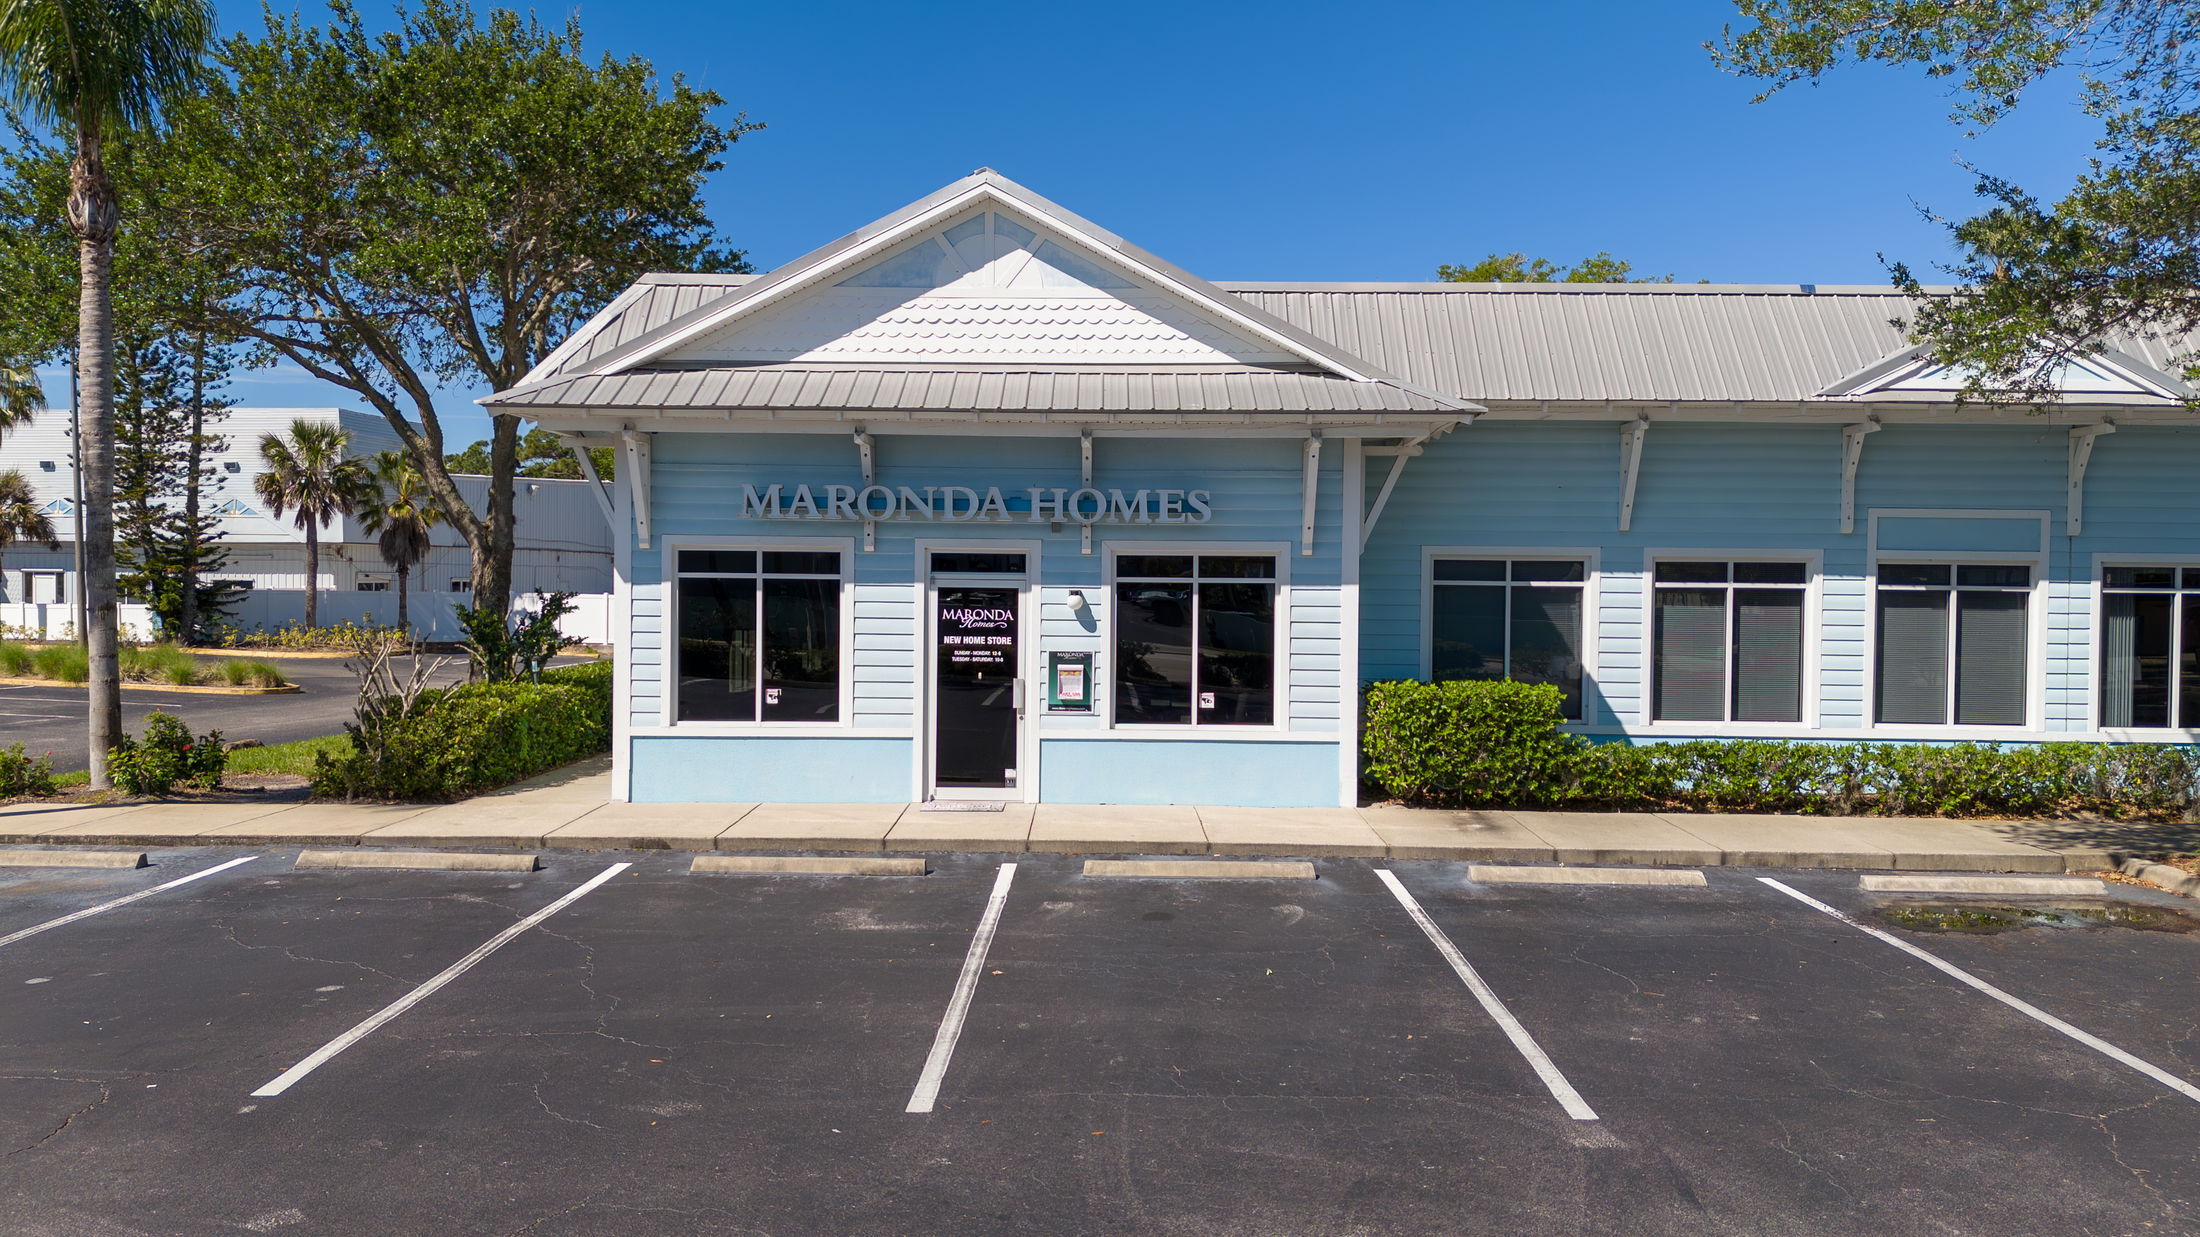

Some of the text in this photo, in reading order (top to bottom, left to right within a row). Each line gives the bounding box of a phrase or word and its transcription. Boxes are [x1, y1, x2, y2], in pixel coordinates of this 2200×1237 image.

[743, 484, 1211, 523] MARONDA HOMES
[942, 608, 1014, 621] MARONDA
[959, 617, 1007, 628] Homes
[943, 635, 1012, 645] NEW HOME STORE
